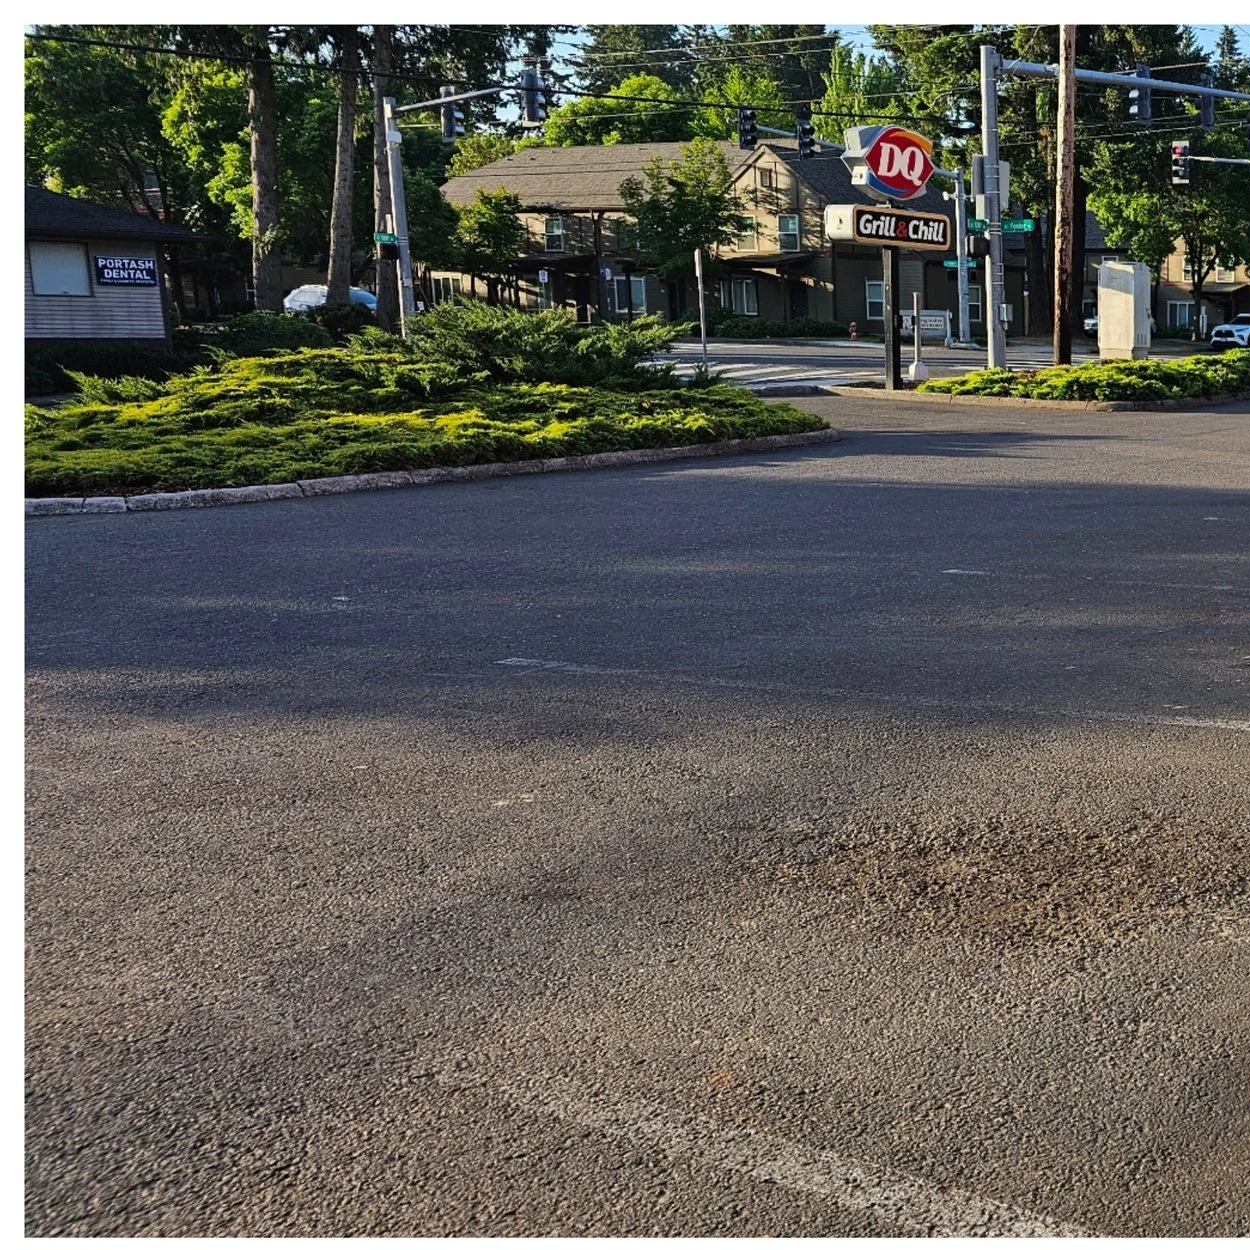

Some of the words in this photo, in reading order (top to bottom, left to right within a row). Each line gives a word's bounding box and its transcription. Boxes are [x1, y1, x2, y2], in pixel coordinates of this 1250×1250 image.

[877, 142, 924, 186] DQ
[859, 213, 896, 237] Grill
[896, 221, 908, 238] &
[908, 219, 945, 242] Chill
[98, 258, 154, 270] PORTASH
[104, 269, 151, 280] DENTAL
